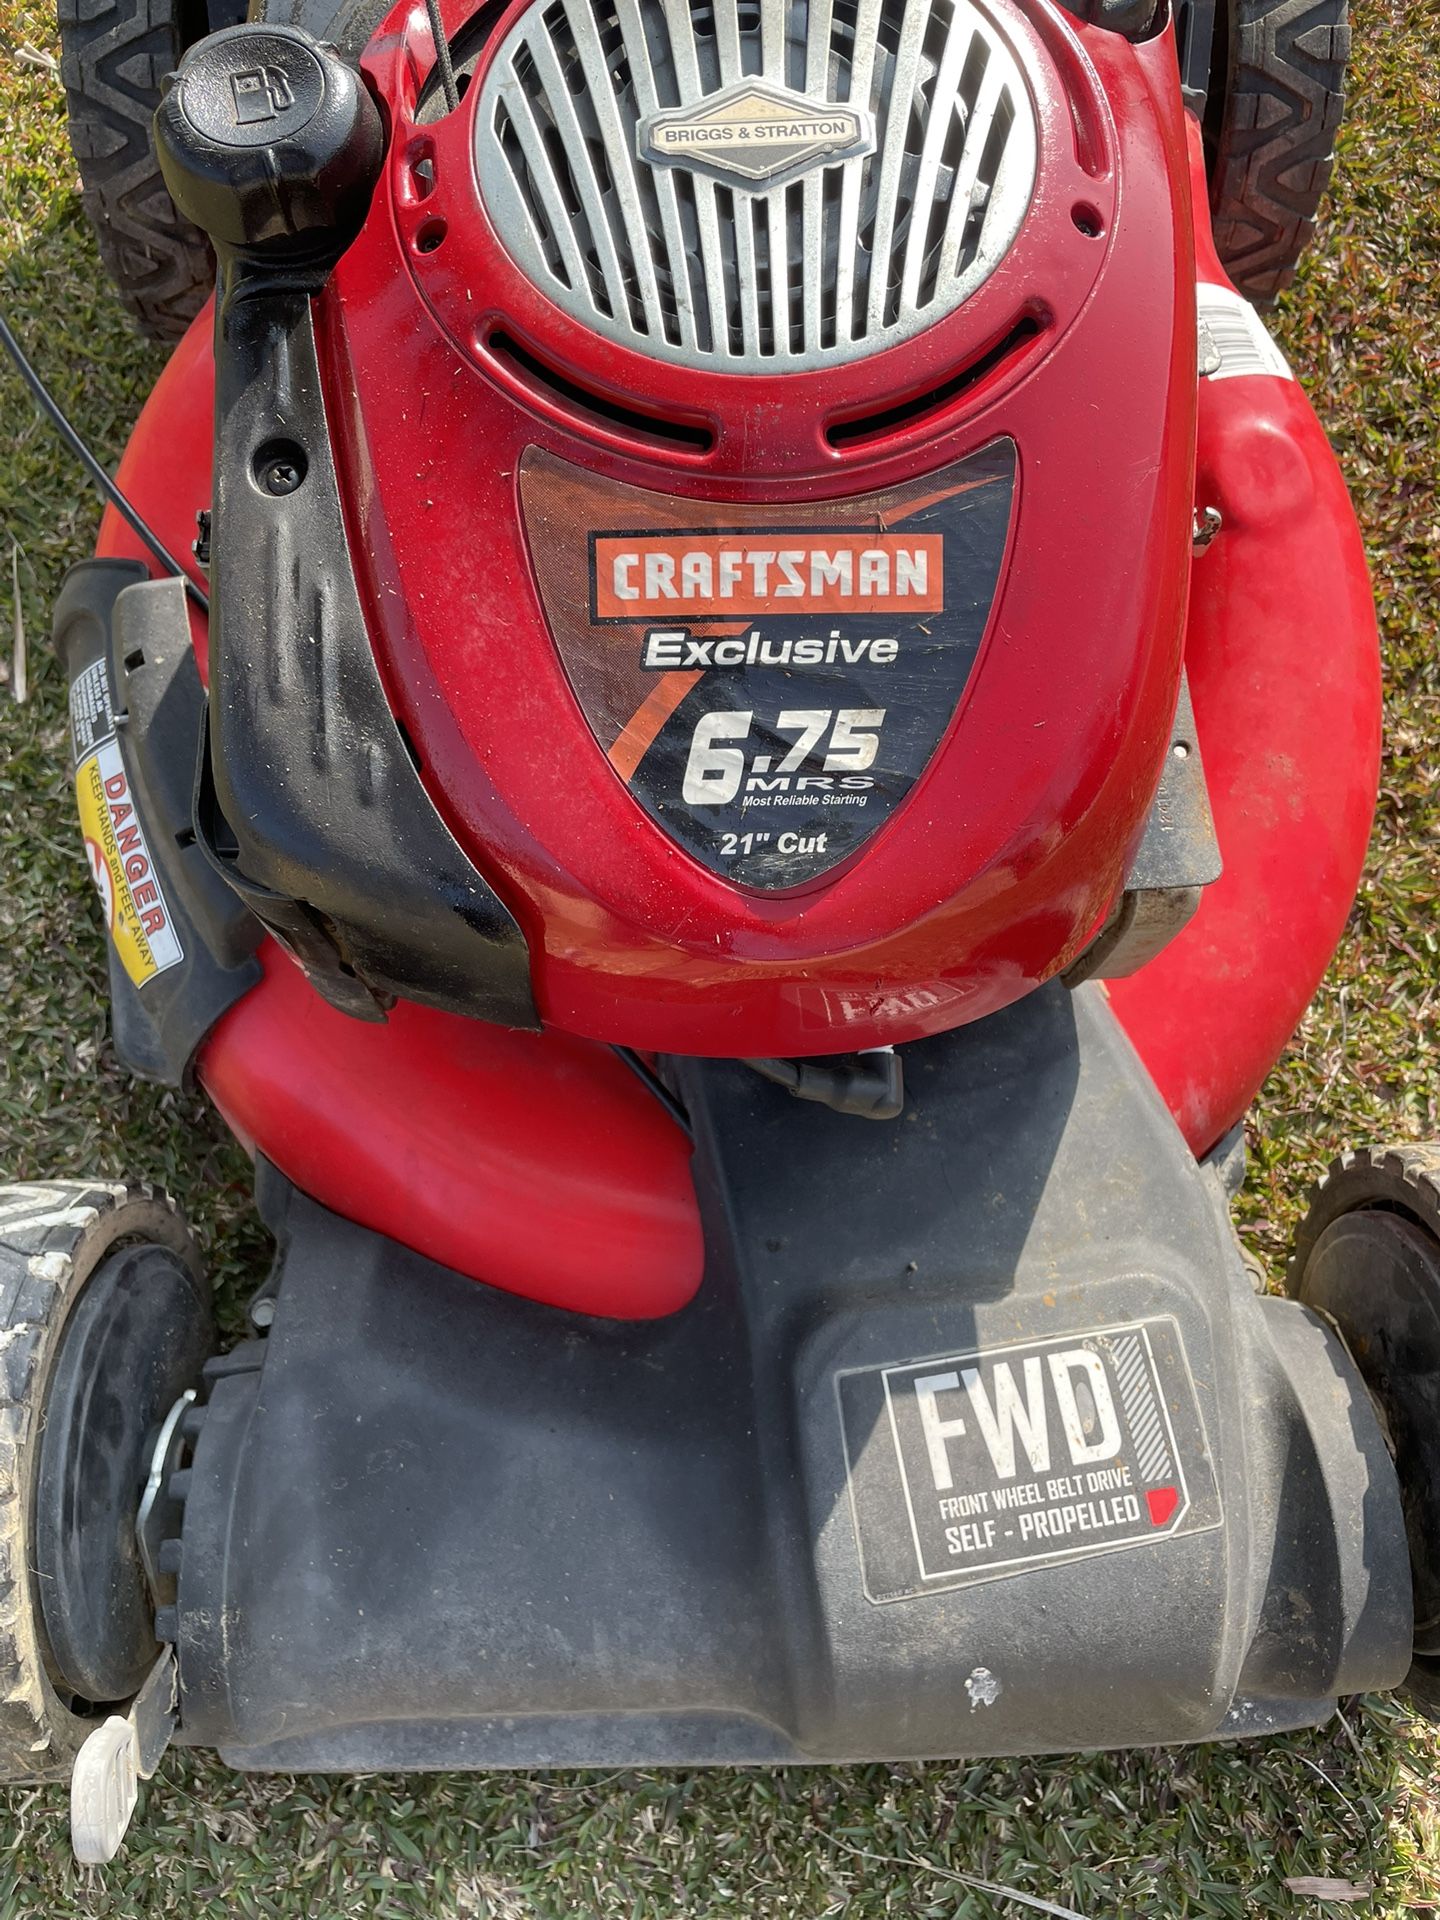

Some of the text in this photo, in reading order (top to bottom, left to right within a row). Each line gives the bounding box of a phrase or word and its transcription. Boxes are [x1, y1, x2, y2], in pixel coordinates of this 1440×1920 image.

[665, 121, 846, 143] BRIGGS & STRATTON
[612, 549, 928, 600] CRAFTSMAN
[645, 630, 899, 666] Exclusive
[682, 708, 887, 805] 6.75
[742, 793, 868, 807] Most Reliable Starting
[745, 776, 875, 791] MRS
[89, 764, 154, 966] KEEP HANDS and FEET AWAY
[104, 771, 167, 937] DANGER
[720, 832, 827, 855] 21" Cut
[914, 1348, 1122, 1490] FWD
[939, 1466, 1133, 1520] FRONT WHEEL BELT DRIVE
[945, 1519, 997, 1554] SELF
[1018, 1494, 1141, 1541] PROPELLED
